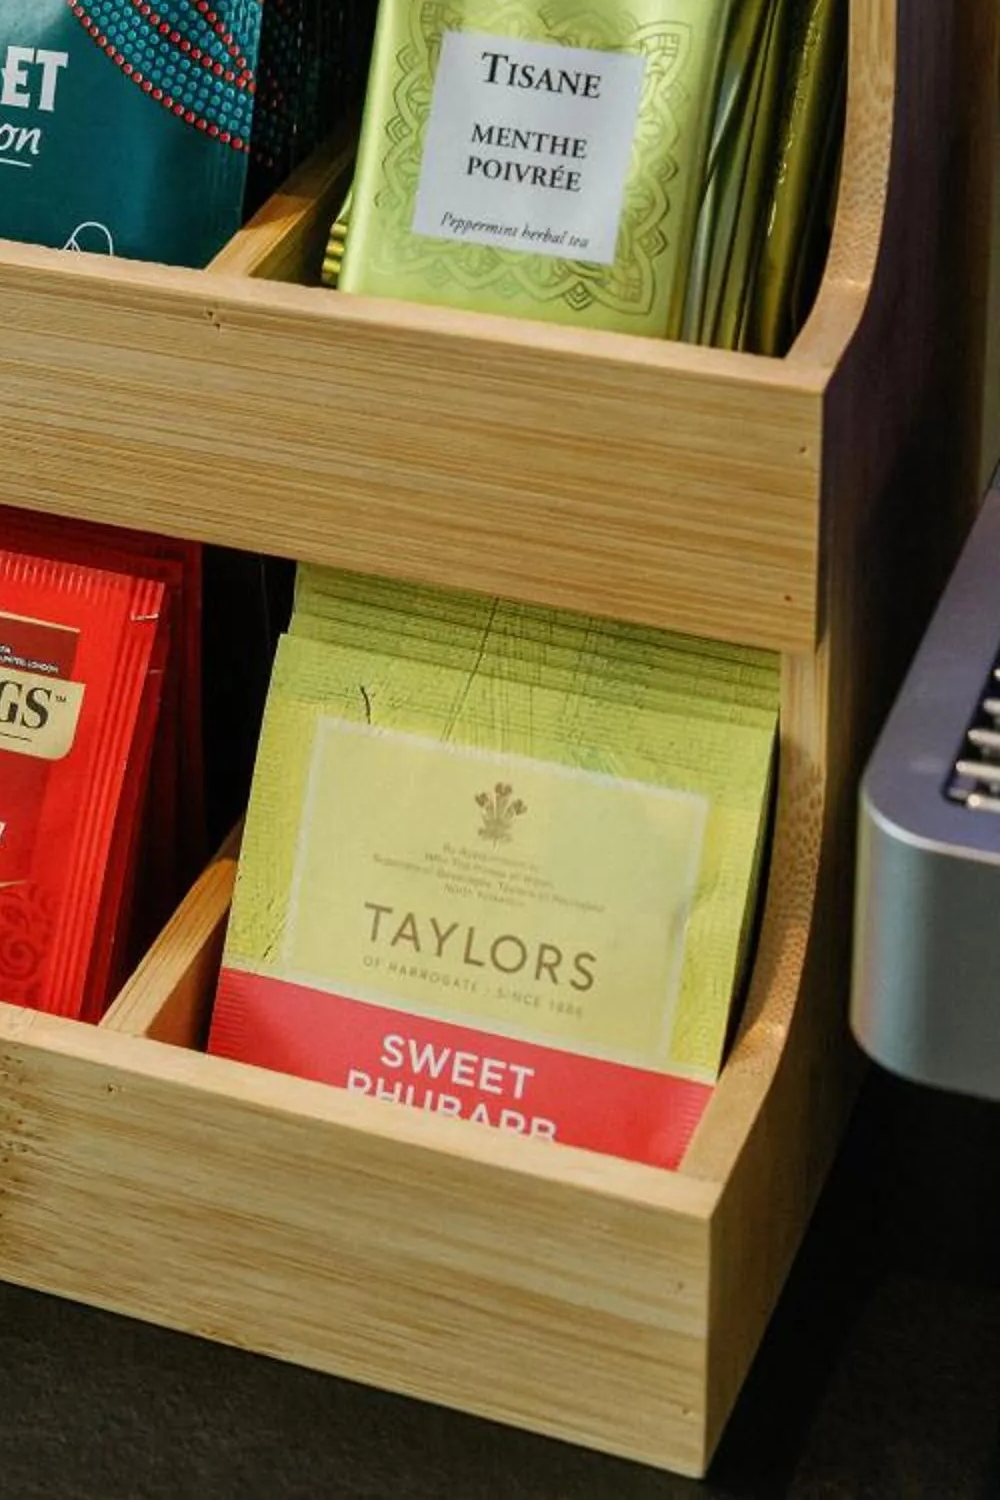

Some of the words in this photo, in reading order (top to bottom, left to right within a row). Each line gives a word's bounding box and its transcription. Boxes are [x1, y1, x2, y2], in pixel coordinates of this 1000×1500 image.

[481, 52, 601, 99] TISANE
[470, 123, 588, 160] MENTHE
[466, 155, 582, 193] POIVRÉE
[440, 211, 517, 238] Peppermint
[521, 223, 566, 246] herbal
[569, 233, 589, 248] tea
[363, 901, 598, 992] TAYLORS
[363, 954, 381, 967] OF
[388, 961, 479, 992] HARROGATE
[496, 987, 541, 1009] SINCE
[380, 1034, 535, 1099] SWEET
